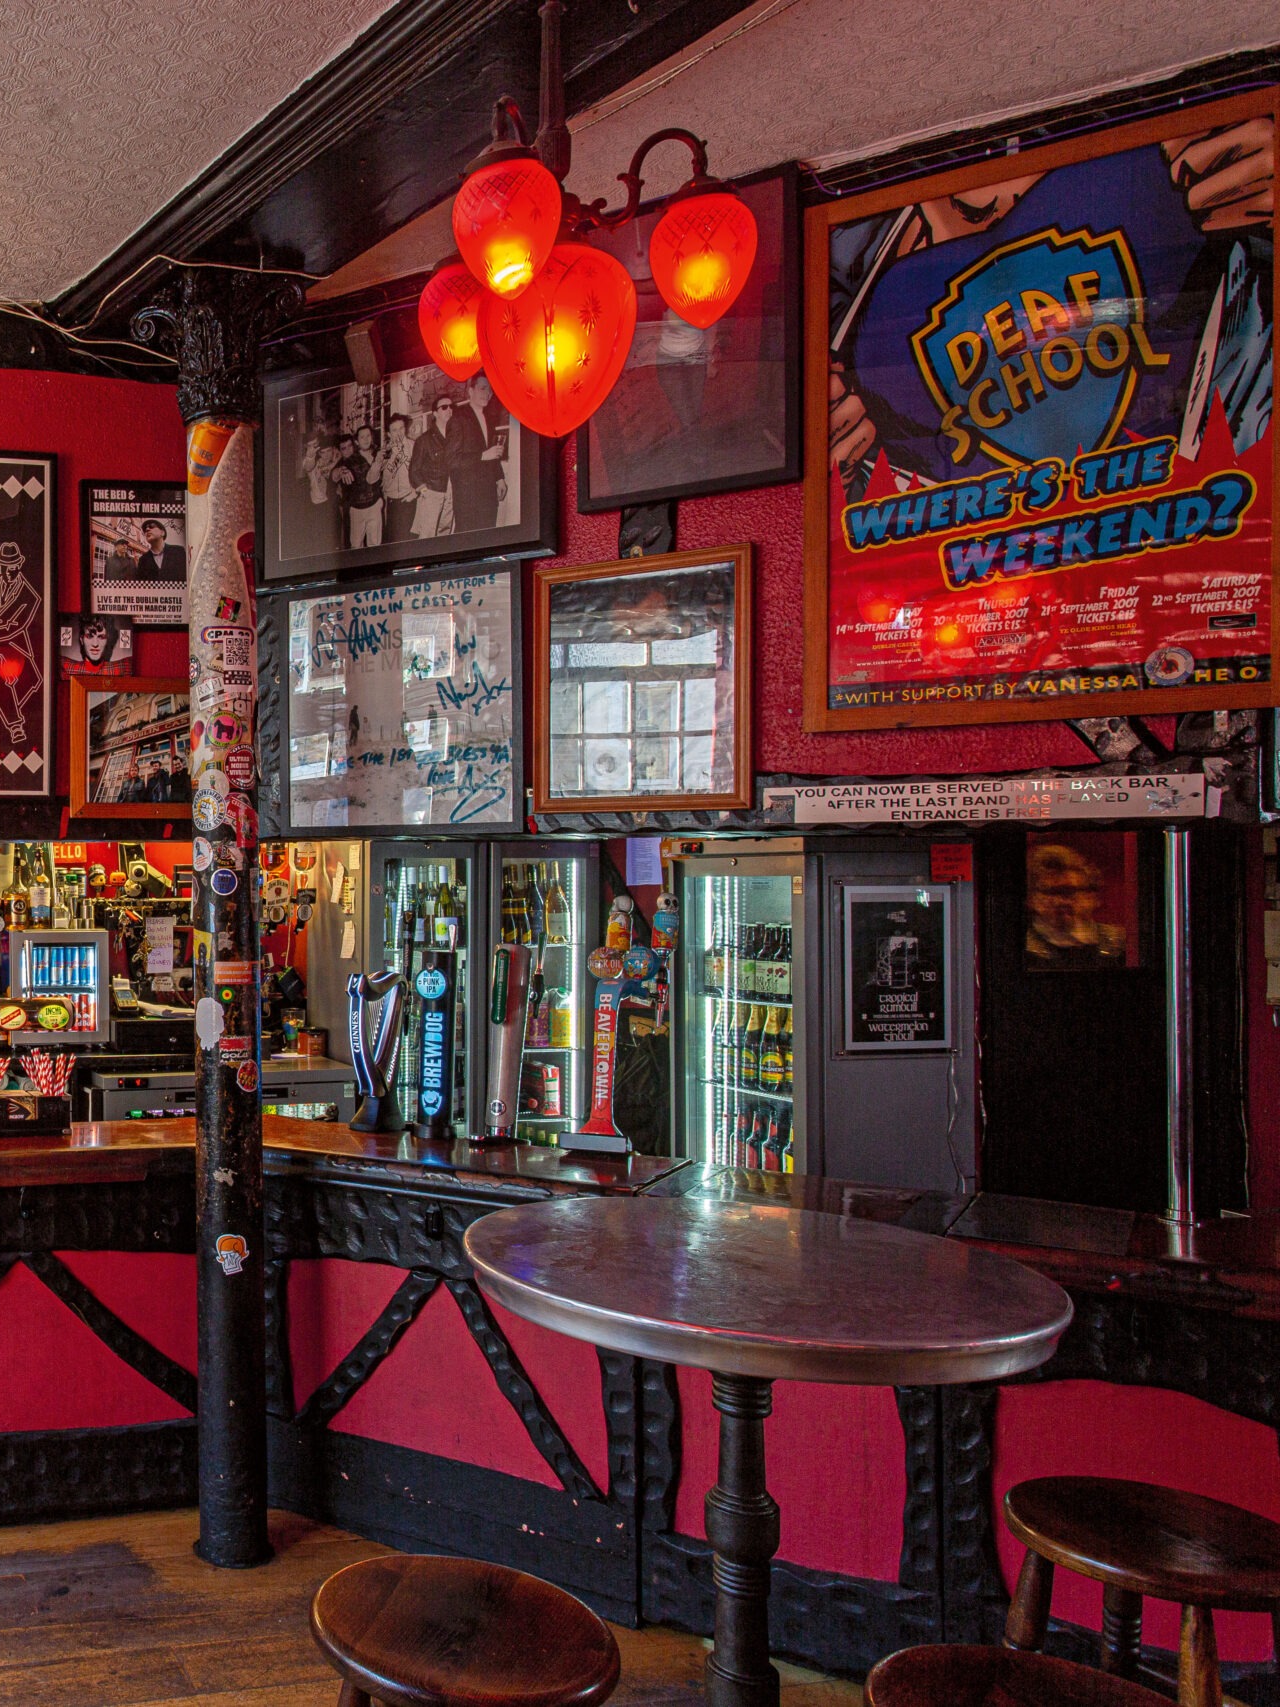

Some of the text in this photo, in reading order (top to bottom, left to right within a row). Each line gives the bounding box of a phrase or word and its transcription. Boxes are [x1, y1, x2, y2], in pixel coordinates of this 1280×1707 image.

[945, 270, 1101, 388] DEAF
[940, 322, 1171, 465] SCHOOL
[93, 489, 109, 499] THE
[111, 490, 126, 499] BED
[848, 442, 1175, 546] WHERE'S THE
[94, 502, 160, 513] BREAKFAST MEN
[946, 479, 1244, 583] WEEKEND?
[354, 573, 496, 603] STAFF AND PATRONS
[1202, 573, 1262, 589] SATURDAY
[1100, 586, 1139, 599] FRIDAY
[1175, 591, 1228, 603] SEPTEMBER
[1233, 586, 1261, 598] 2007
[351, 600, 403, 618] DUBLIN
[1060, 602, 1109, 614] SEPTEMBER
[1113, 597, 1139, 609] 2007
[1190, 601, 1233, 614] TICKETS
[956, 608, 1029, 623] SEPTEMBER 2007
[1077, 611, 1116, 624] TICKETS
[875, 629, 909, 641] TICKETS
[967, 621, 1003, 633] TICKETS
[902, 684, 986, 701] SUPPORT
[995, 682, 1017, 696] BY
[1027, 674, 1139, 693] VANESSA
[795, 788, 826, 798] YOU
[831, 787, 863, 797] CAN
[868, 785, 905, 796] NOW
[910, 784, 931, 794] BE
[936, 782, 1004, 794] SERVED
[1031, 780, 1064, 791] THE
[1071, 779, 1124, 790] BACK
[1129, 777, 1170, 788] BAR
[827, 799, 875, 809] AFTER
[880, 798, 911, 808] THE
[916, 796, 957, 807] LAST
[963, 795, 1010, 806] BAND
[1015, 794, 1052, 804] HAS
[891, 808, 1051, 820] ENTRANCE IS FREE
[423, 978, 440, 986] PUNK
[351, 1010, 361, 1053] GUINNESS
[424, 1012, 443, 1088] BREWDOG
[594, 993, 613, 1099] BEAVERTOWN
